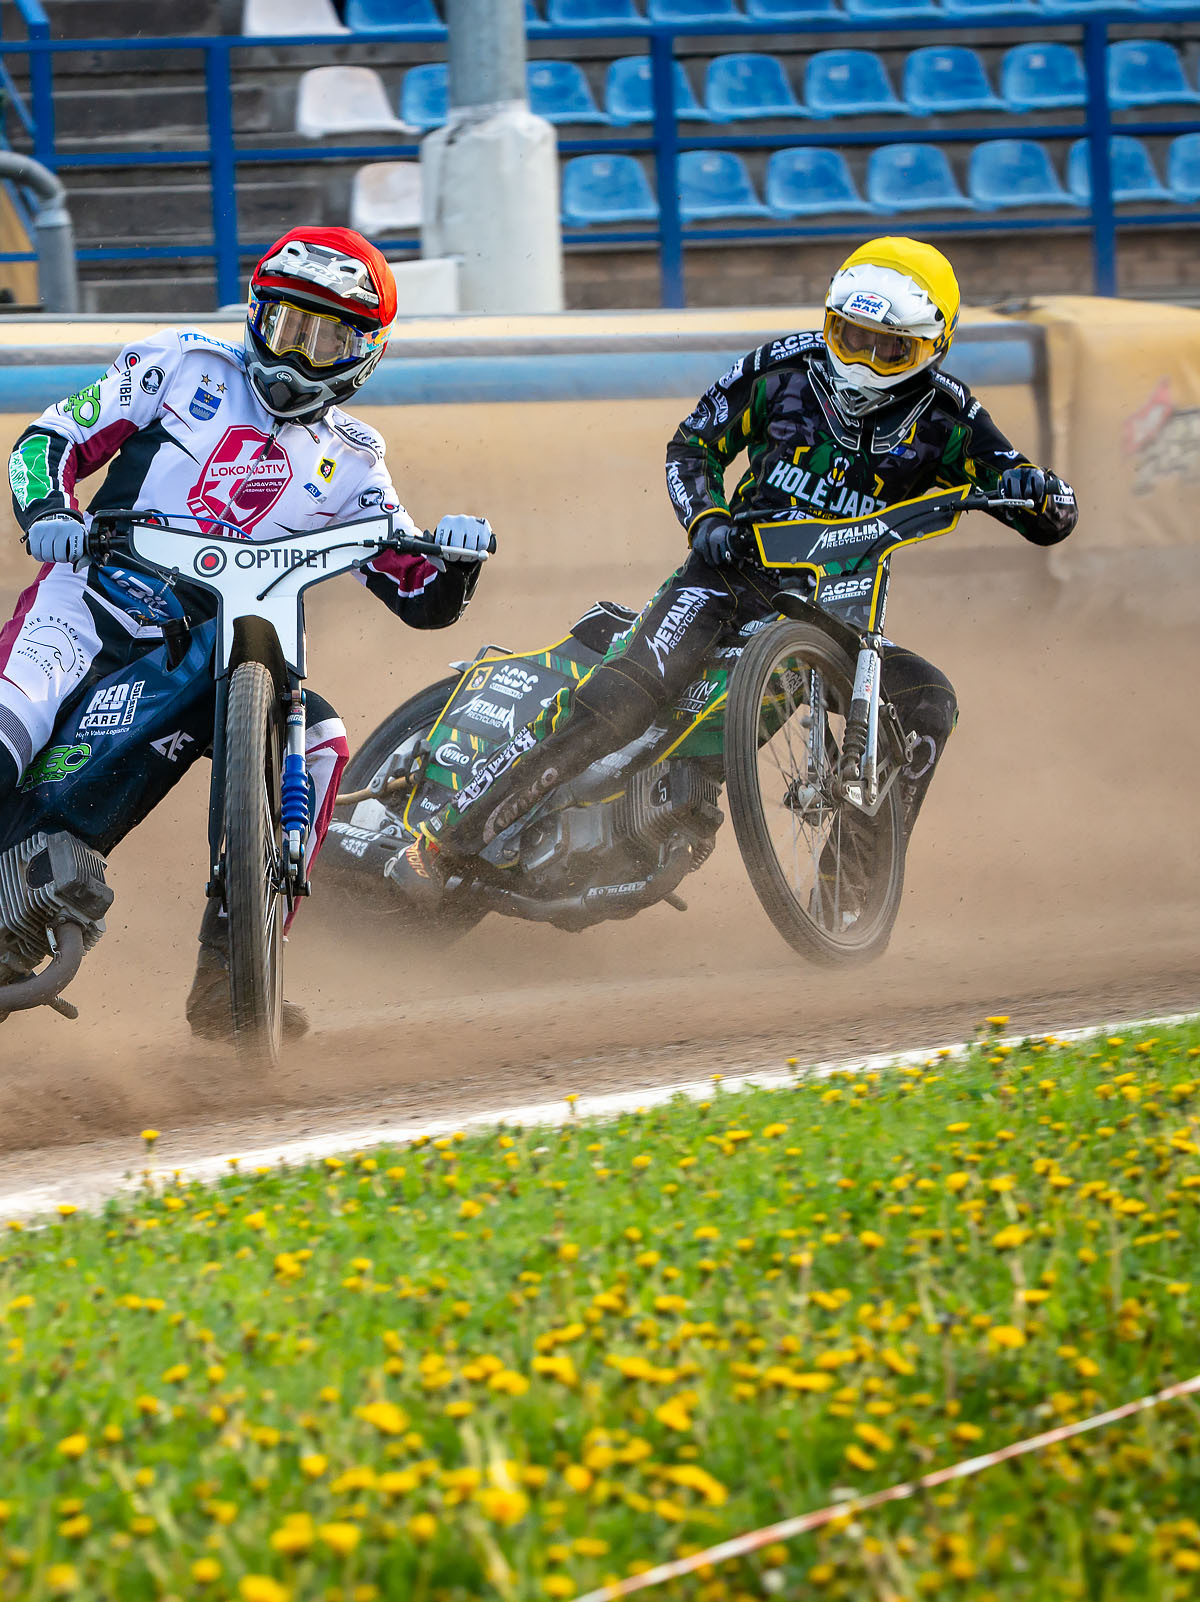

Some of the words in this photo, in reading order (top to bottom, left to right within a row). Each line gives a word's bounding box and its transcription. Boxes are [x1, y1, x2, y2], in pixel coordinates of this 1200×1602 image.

[850, 303, 879, 315] MAK
[854, 294, 884, 309] Smak
[211, 463, 286, 477] LOKOMOTIV
[806, 518, 902, 560] METALIKA
[826, 533, 878, 549] RECYCLING
[235, 549, 330, 569] OPTIBET
[820, 578, 873, 599] ACDC
[24, 617, 42, 630] THE
[49, 615, 79, 641] BEACH
[645, 586, 729, 678] METALIKA
[86, 683, 130, 714] RED
[450, 693, 515, 738] METALIKA
[466, 712, 503, 729] RECYCLING
[442, 747, 470, 765] WIKO
[340, 837, 369, 858] #333
